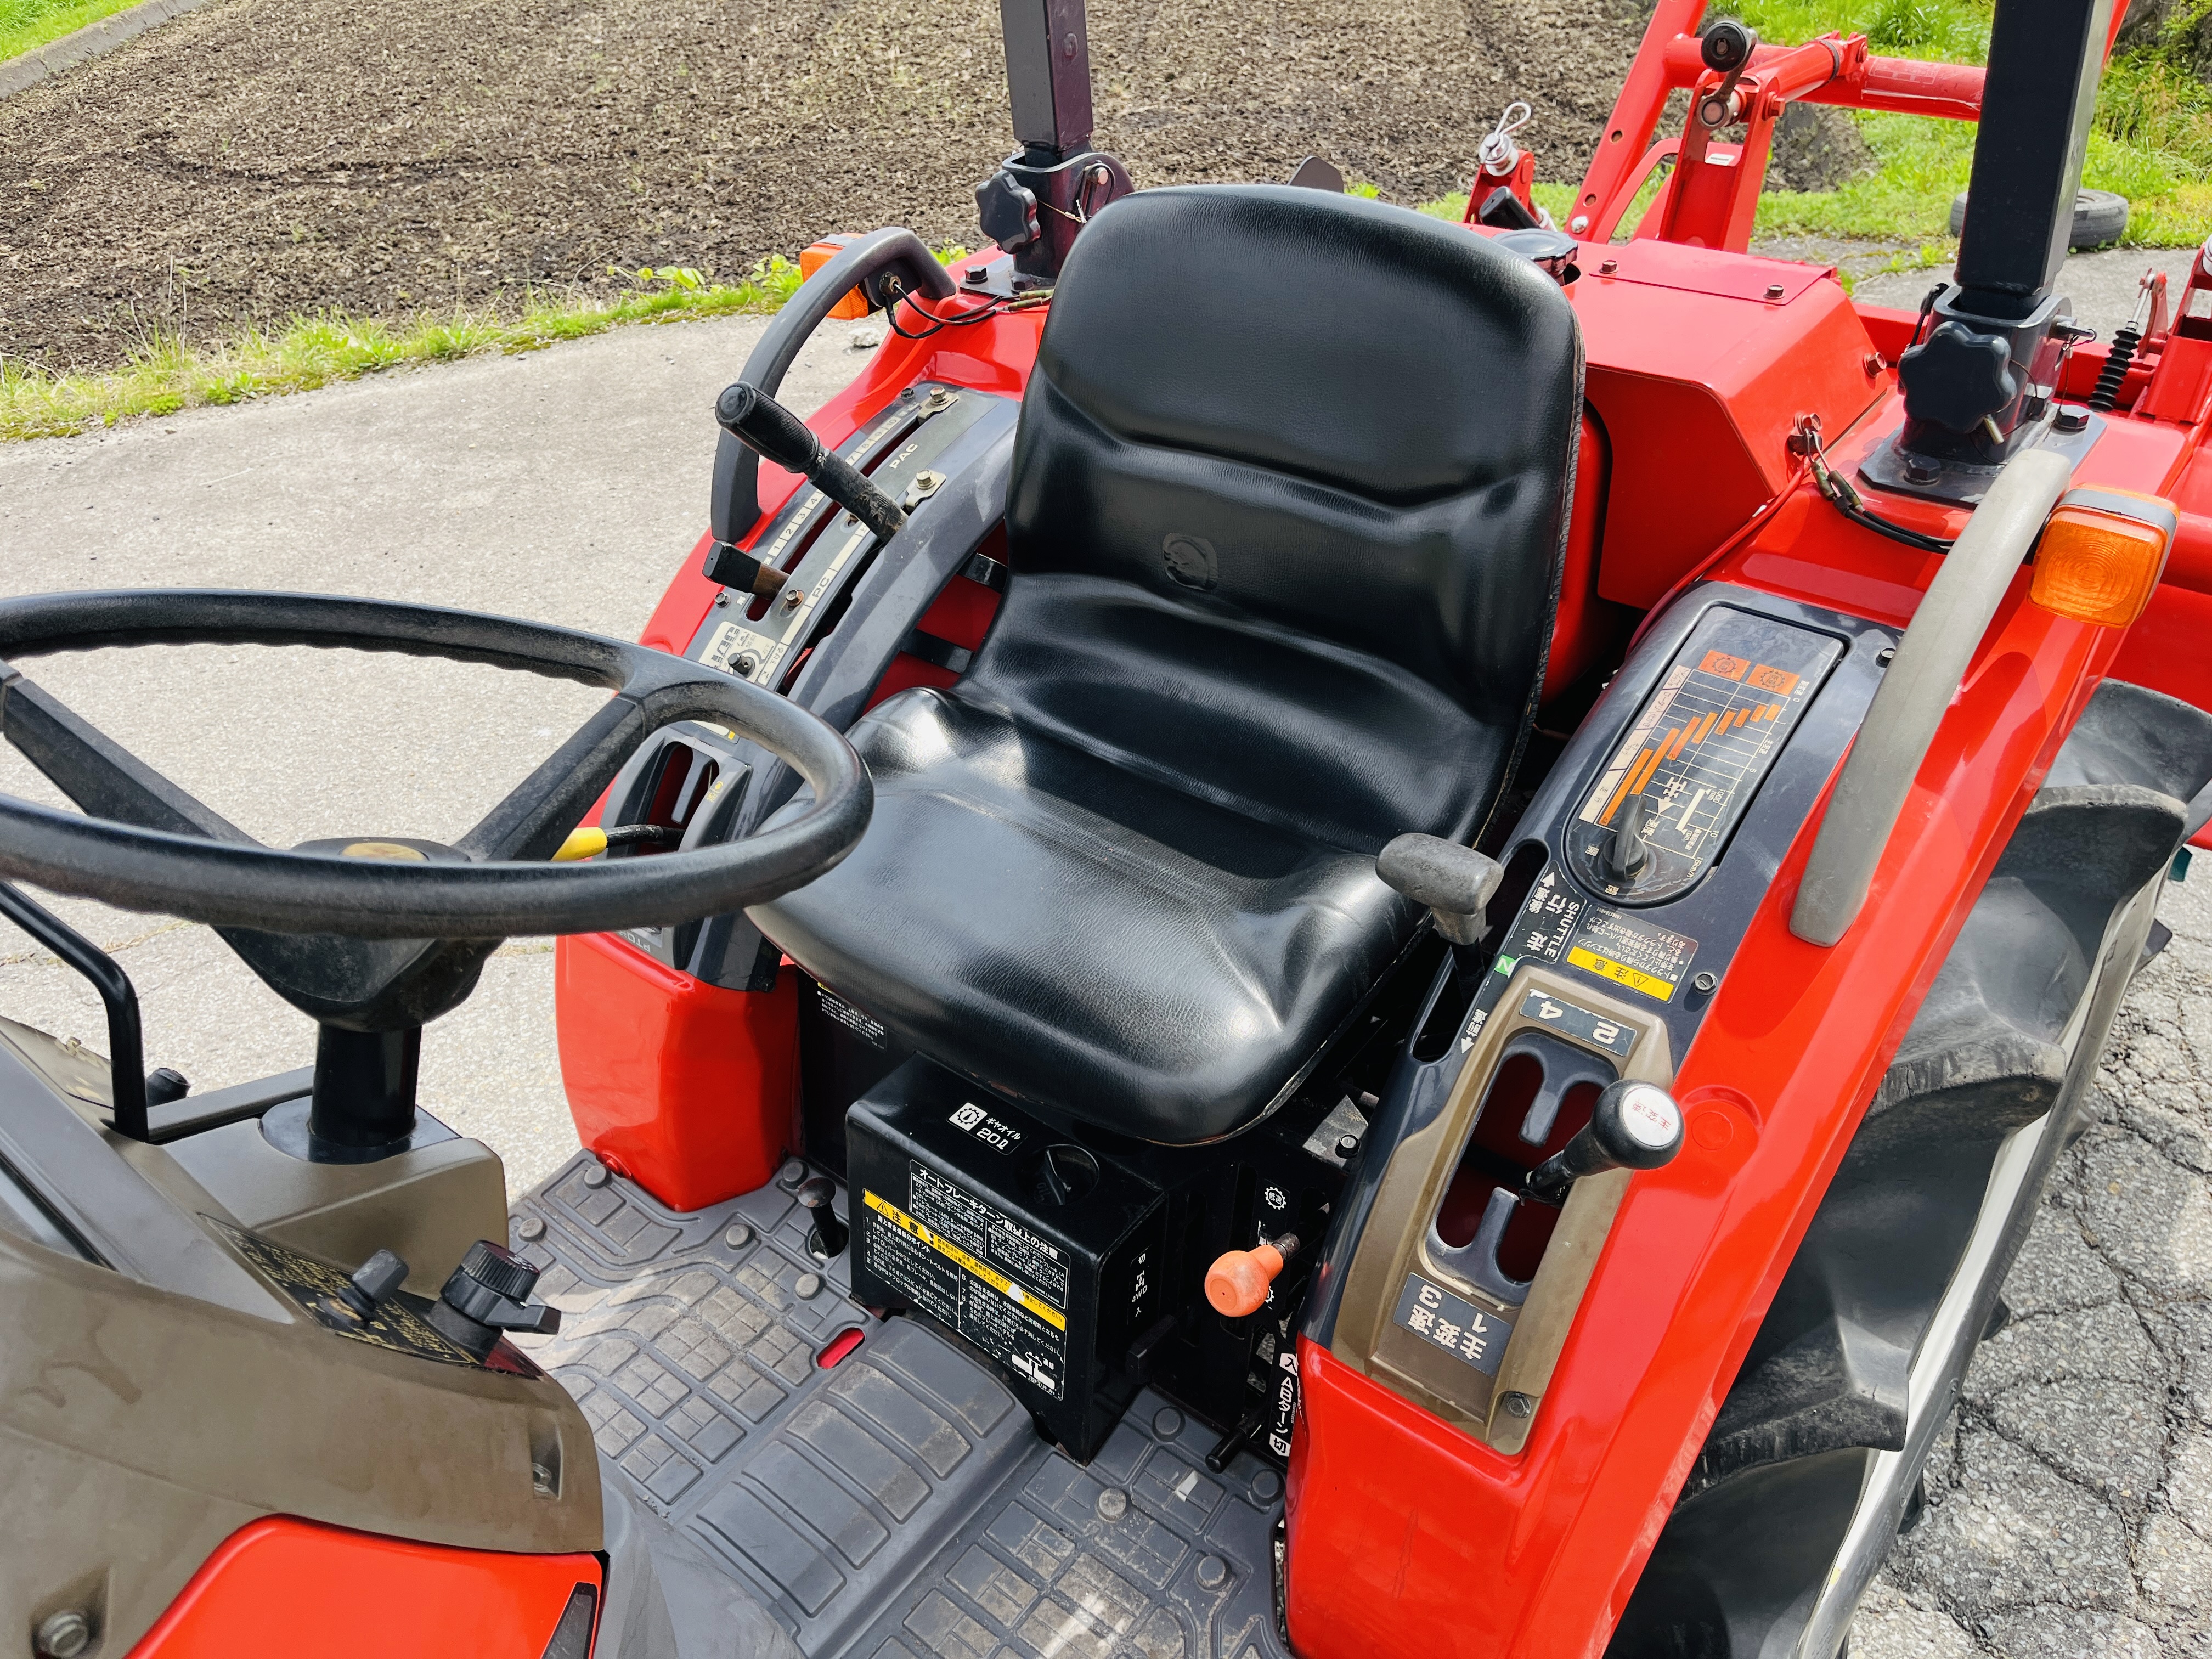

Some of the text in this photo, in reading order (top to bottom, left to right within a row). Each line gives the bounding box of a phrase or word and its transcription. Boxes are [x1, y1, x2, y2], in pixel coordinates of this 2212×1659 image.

[889, 443, 918, 469] PAC
[812, 577, 830, 598] PC
[770, 648, 784, 665] 下げる
[1655, 691, 1671, 710] ロータリ
[1643, 713, 1656, 727] 代かき
[1758, 739, 1774, 755] 主変速
[1707, 791, 1716, 801] rpm
[1713, 788, 1726, 804] 1000
[1641, 818, 1660, 836] 速度
[1684, 830, 1692, 841] rpm
[1710, 830, 1720, 838] 10
[1686, 856, 1704, 878] 15km/h
[1529, 887, 1550, 914] 後進
[1544, 901, 1580, 958] SHUTTLE
[1657, 932, 1686, 950] あります。
[1497, 958, 1513, 973] N
[1616, 943, 1675, 972] を停止してください。
[1538, 1000, 1564, 1020] 4
[1465, 1008, 1488, 1037] 前進
[1593, 1020, 1620, 1045] 2
[1632, 1099, 1672, 1131] 主変速
[986, 1118, 1021, 1140] ギヤオイル
[1131, 1285, 1148, 1303] 4WD
[1419, 1284, 1443, 1309] 3
[1408, 1304, 1487, 1360] 主変速
[1471, 1312, 1487, 1333] 1
[1284, 1356, 1297, 1373] 入
[1276, 1376, 1294, 1434] ABターン
[1273, 1437, 1286, 1454] 切
